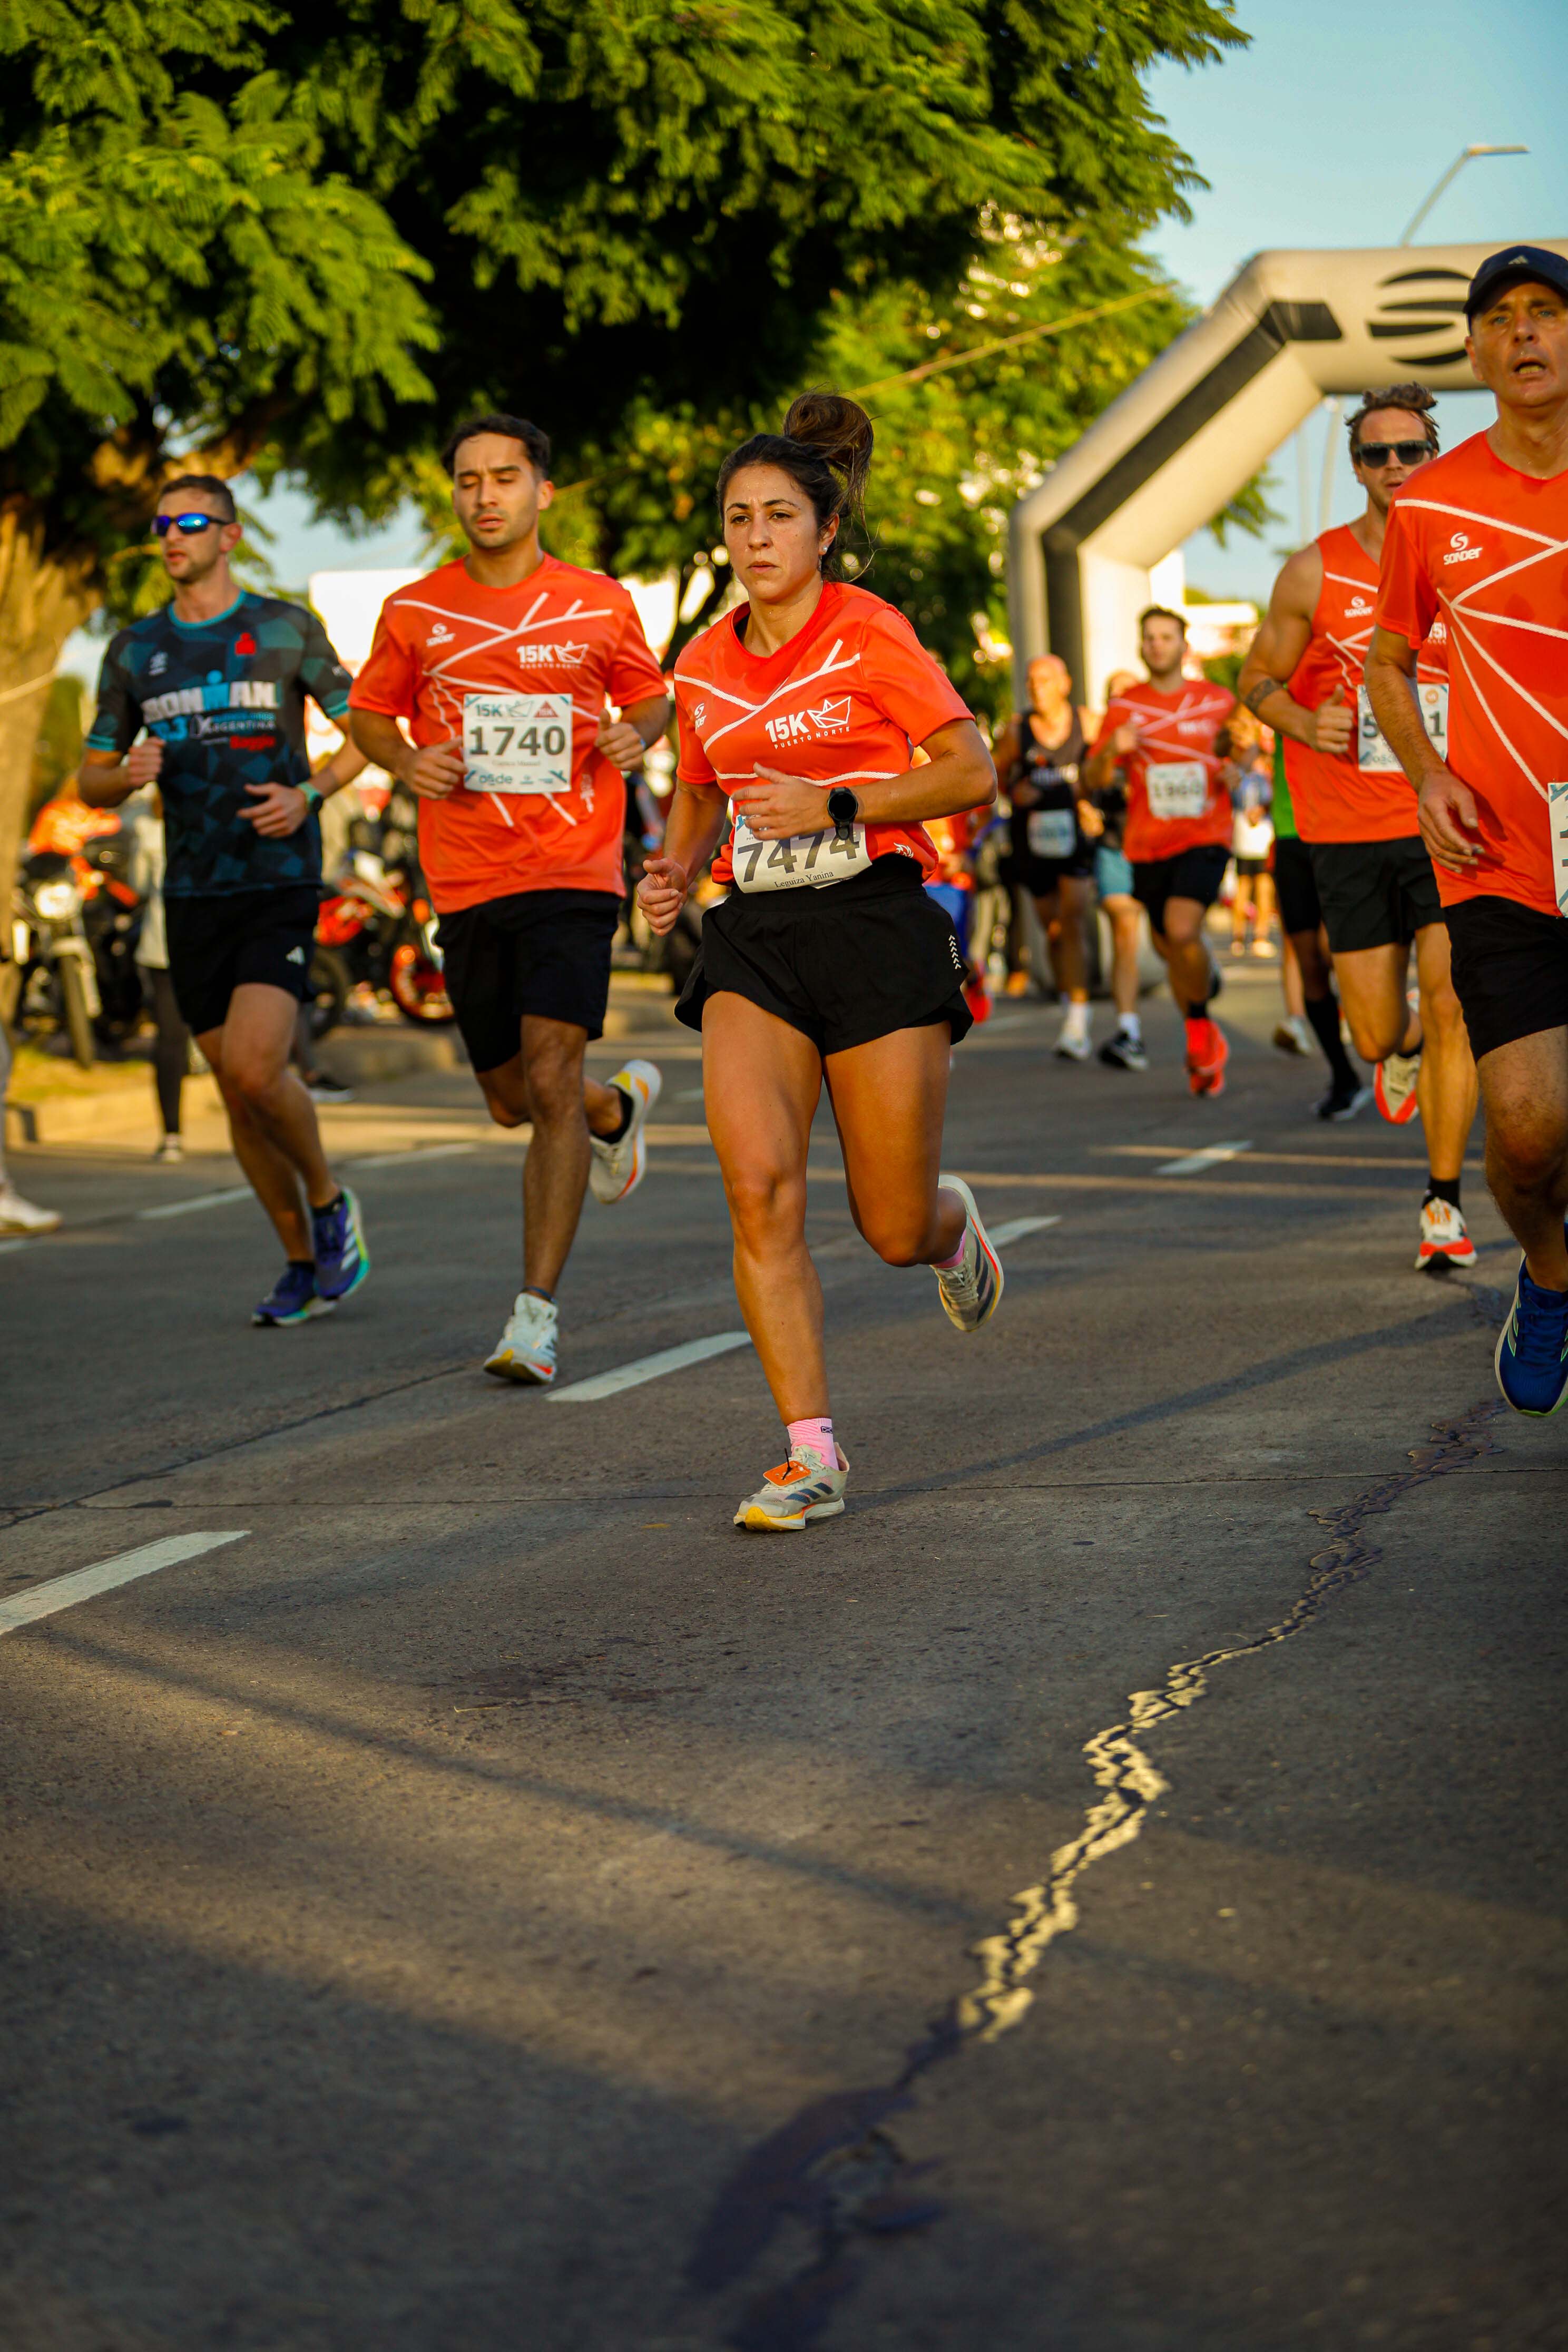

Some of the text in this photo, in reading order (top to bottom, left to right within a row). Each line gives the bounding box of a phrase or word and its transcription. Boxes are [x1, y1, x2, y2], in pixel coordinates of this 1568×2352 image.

[516, 644, 554, 663] 15K
[476, 704, 503, 717] 15K
[765, 711, 810, 742] 15K
[774, 726, 850, 749] PUERTO NORTE
[469, 726, 566, 756] 1740
[737, 830, 860, 883] 7474
[775, 871, 834, 888] Leguiza Yanina
